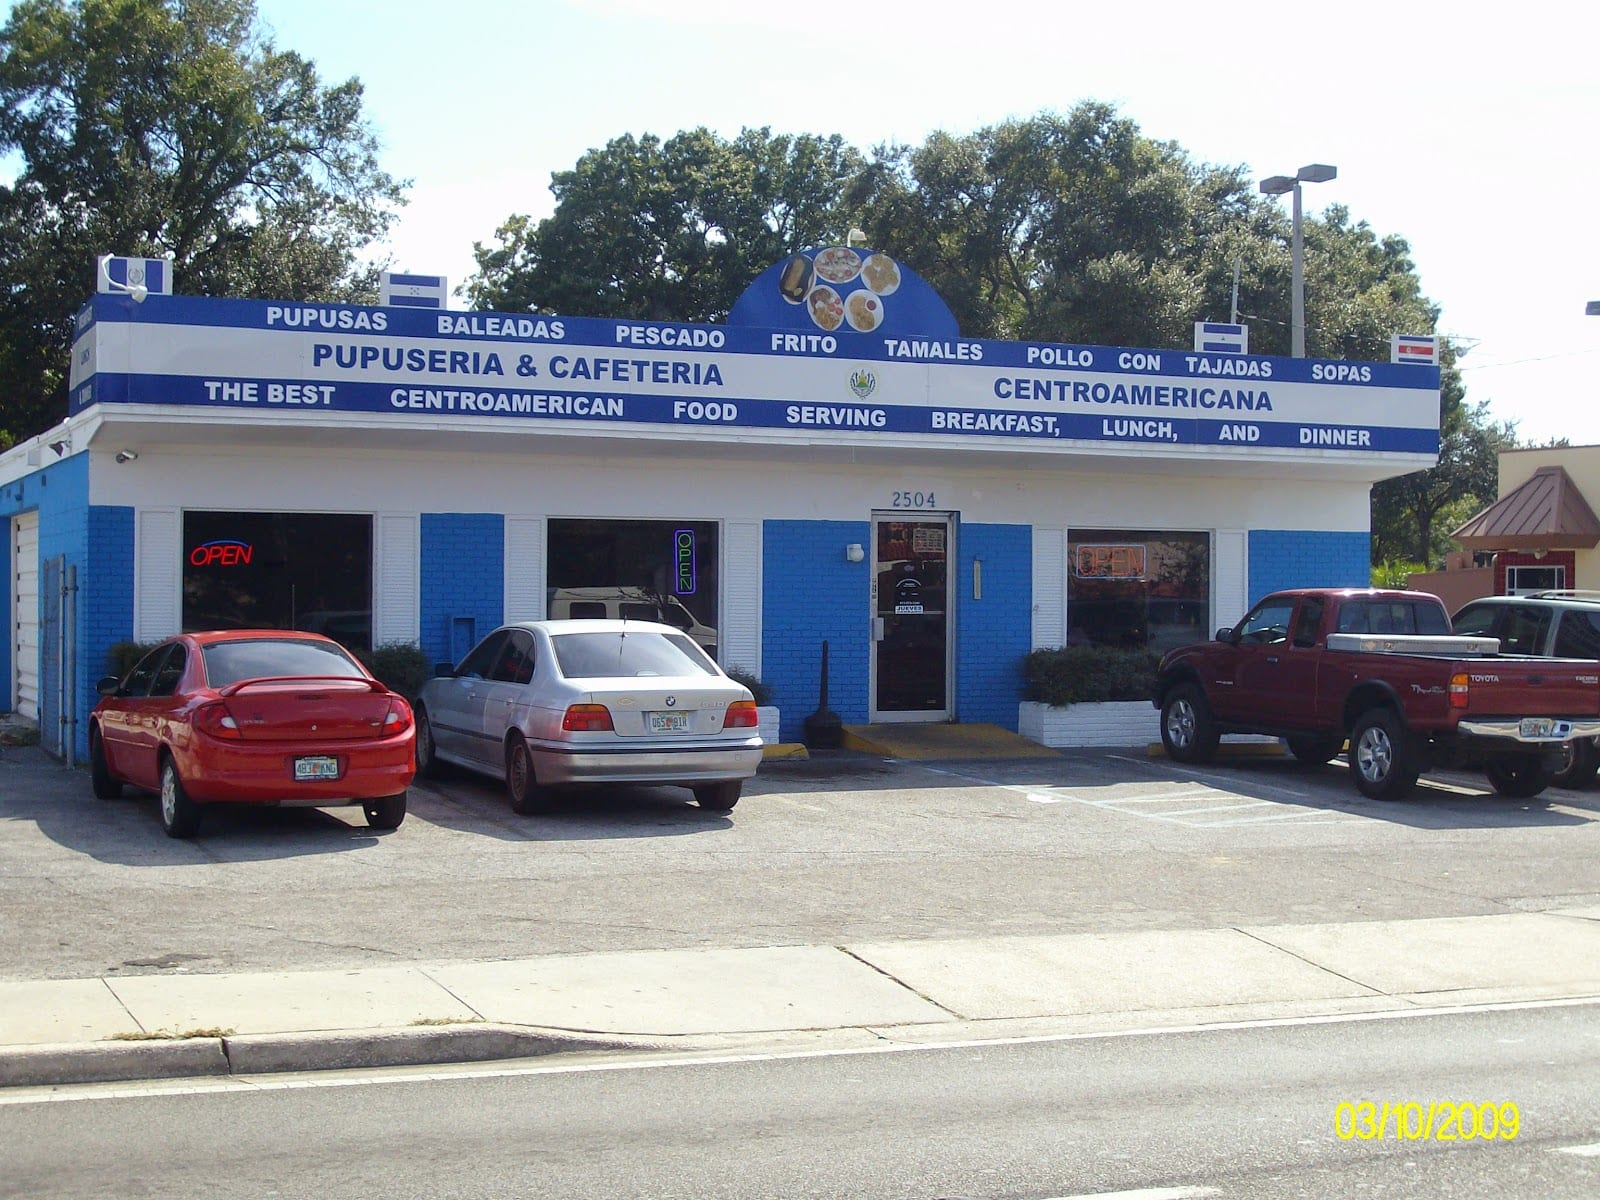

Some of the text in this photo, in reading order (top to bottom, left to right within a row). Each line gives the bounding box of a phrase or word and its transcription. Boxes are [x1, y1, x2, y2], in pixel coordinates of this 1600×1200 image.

[268, 307, 1371, 381] PUPUSAS BALEADAS PESCADO FRITO TAMALES POLLO CON TAJADAS SOPAS
[314, 344, 1272, 411] PUPUSERIA & CAFETERIA CENTROAMERICANA
[205, 382, 1370, 445] THE BEST CENTROAMERICAN FOOD SERVING BREAKFAST, LUNCH, AND DINNER
[892, 491, 936, 508] 2504
[190, 545, 253, 566] OPEN
[677, 533, 692, 591] OPEN
[1079, 547, 1144, 576] OPEN
[1470, 674, 1499, 682] TOYOTA
